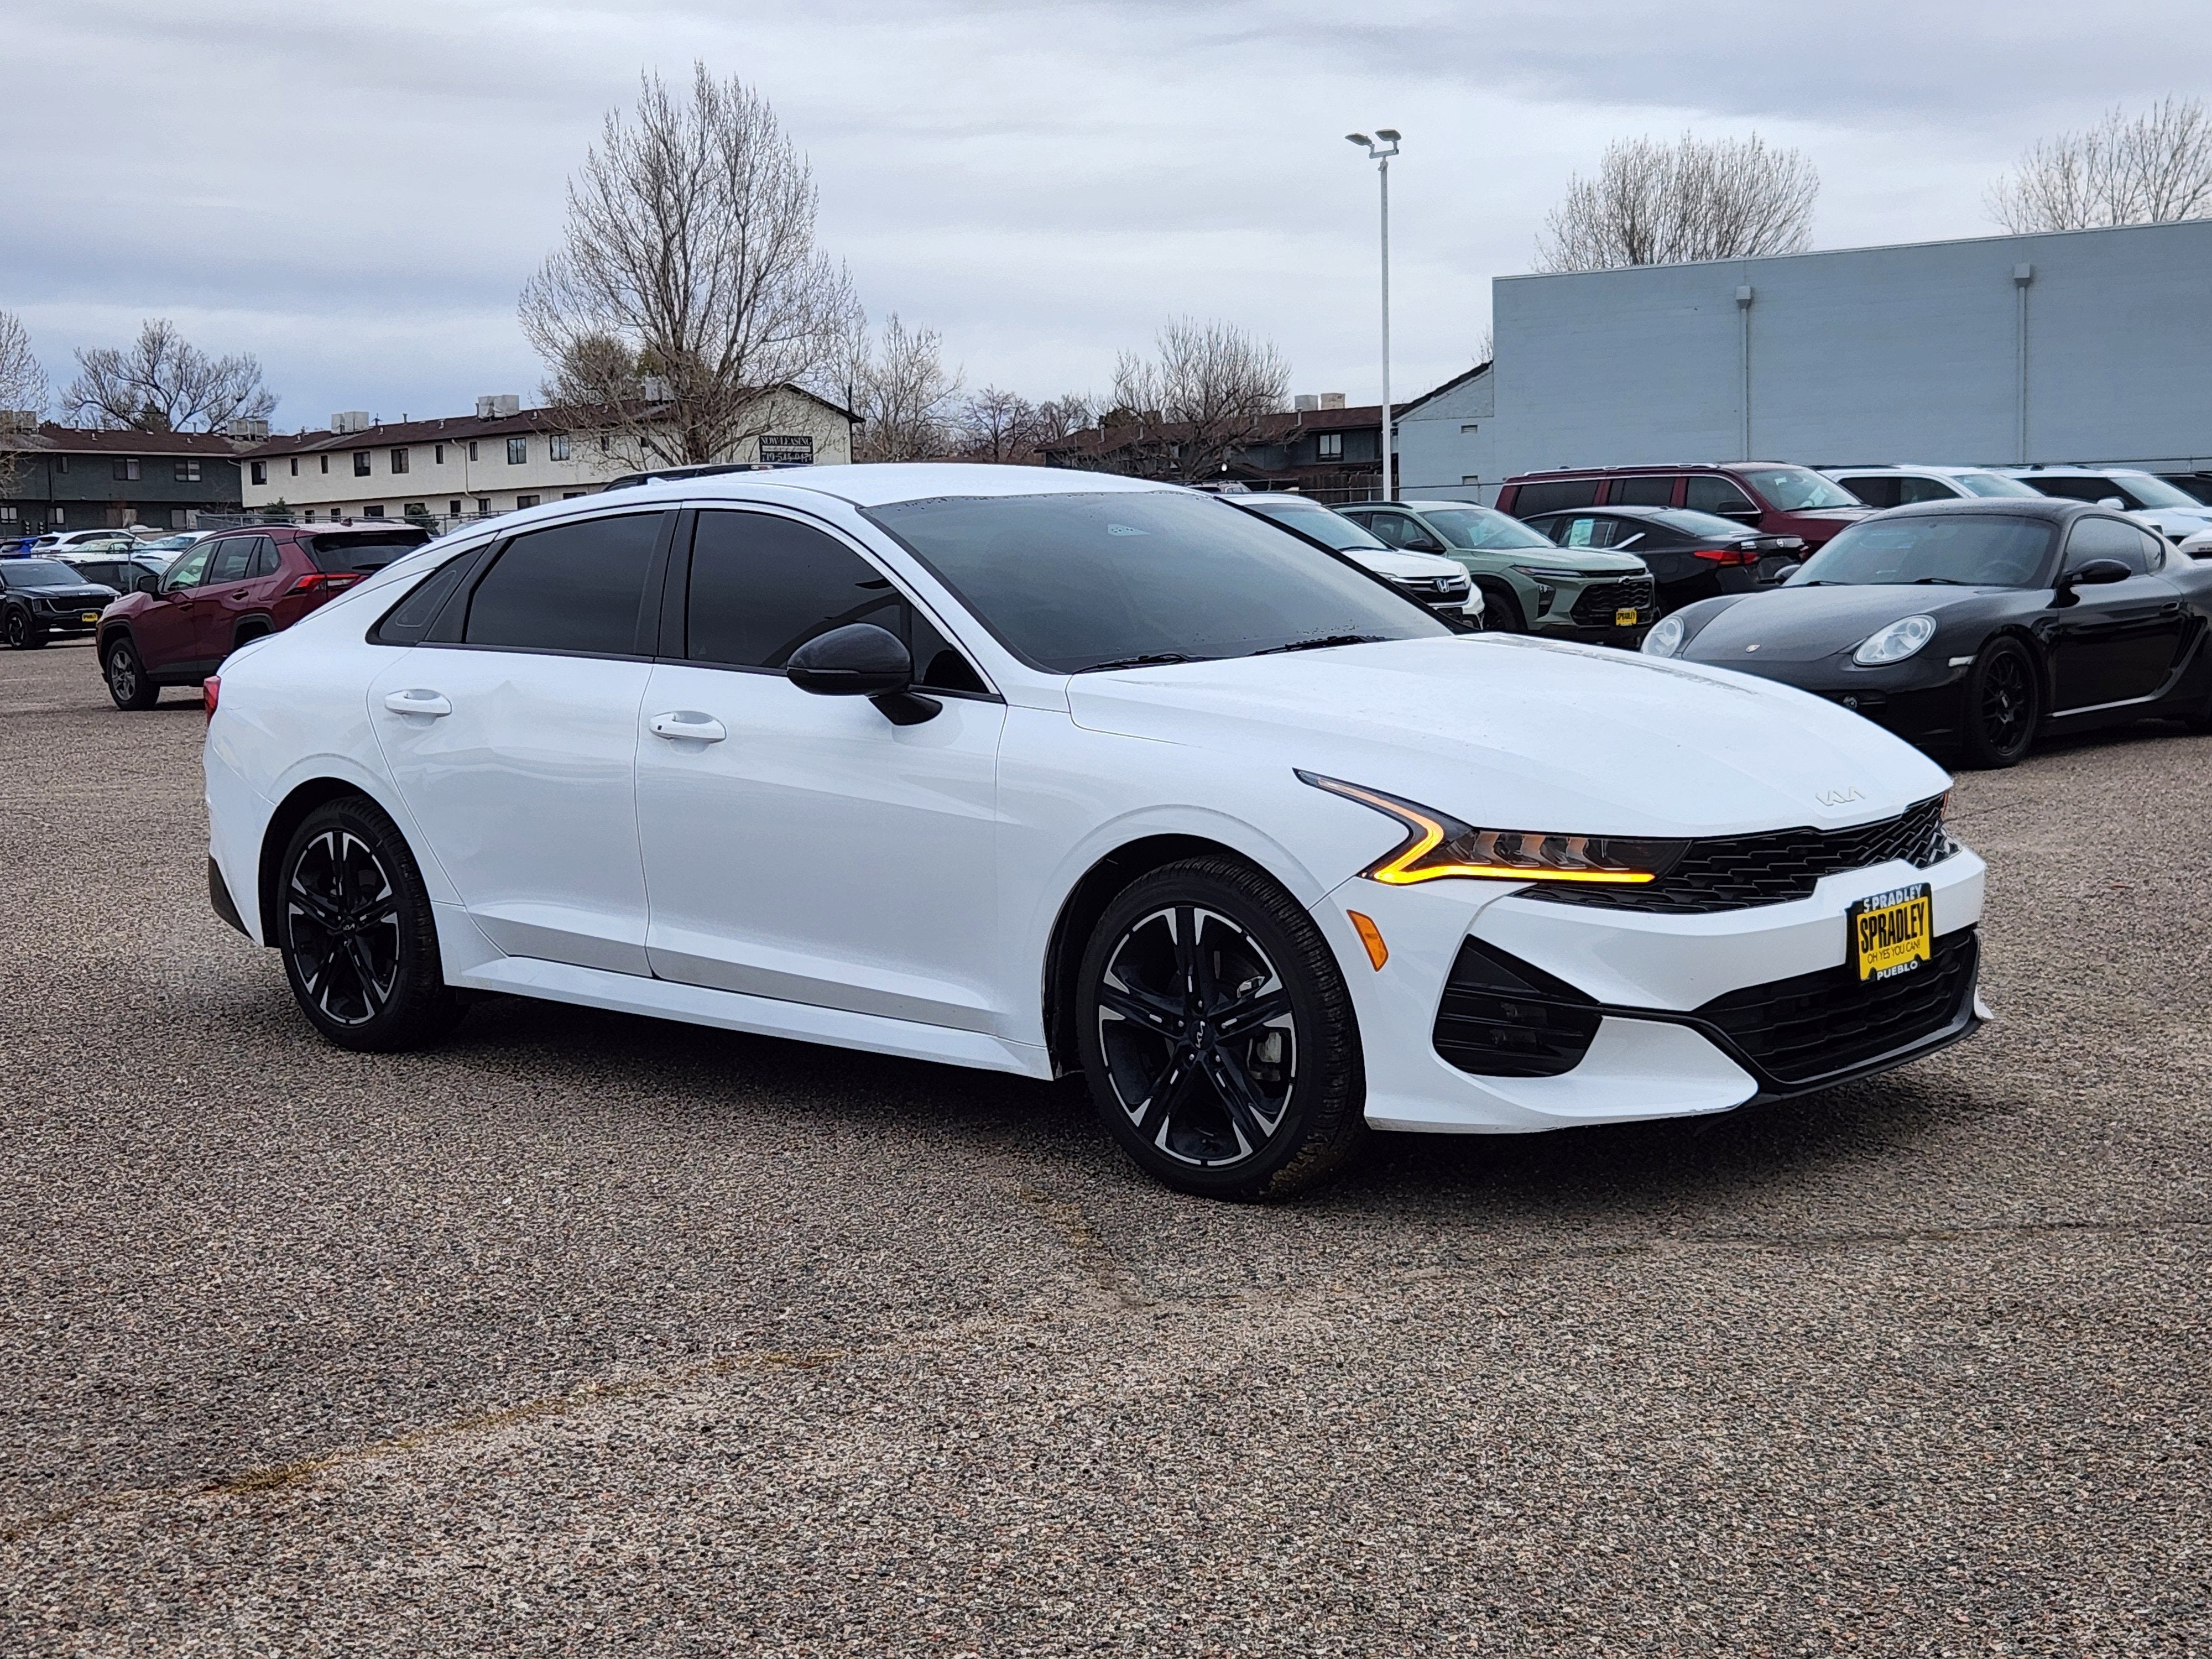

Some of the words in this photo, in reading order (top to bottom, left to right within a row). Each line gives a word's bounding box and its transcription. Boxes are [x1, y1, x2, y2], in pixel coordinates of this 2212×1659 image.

[760, 436, 779, 445] NOW
[780, 436, 812, 445] LEASING
[1864, 884, 1922, 912] SPRADLEY
[1860, 901, 1924, 953] SPRADLEY
[1867, 952, 1878, 964] OH
[1879, 948, 1890, 960] YES
[1891, 943, 1905, 957] YOU
[1877, 961, 1918, 980] PUEBLO
